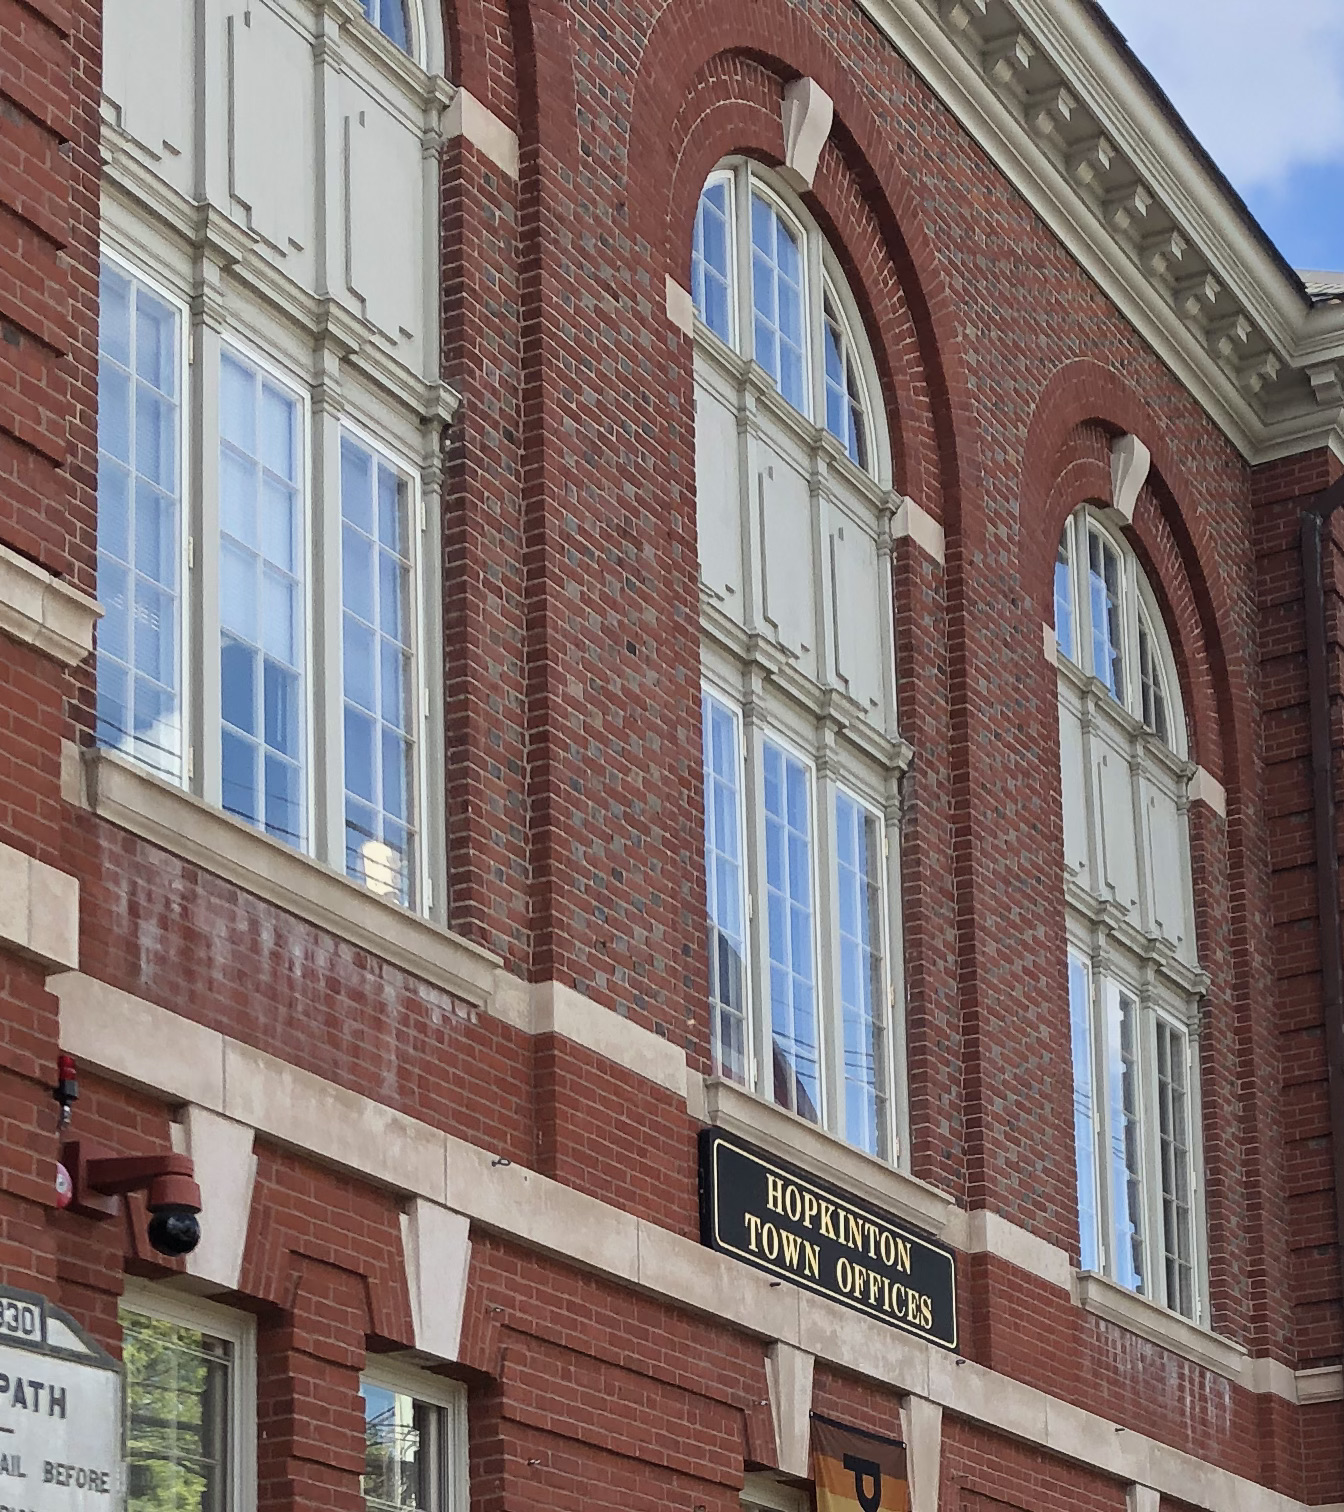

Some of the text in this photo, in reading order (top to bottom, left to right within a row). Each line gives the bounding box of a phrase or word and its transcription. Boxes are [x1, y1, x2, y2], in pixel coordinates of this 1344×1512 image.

[744, 1212, 933, 1330] TOWN OFFICES
[766, 1173, 912, 1275] HOPKINTON
[43, 1460, 110, 1494] BEFORE
